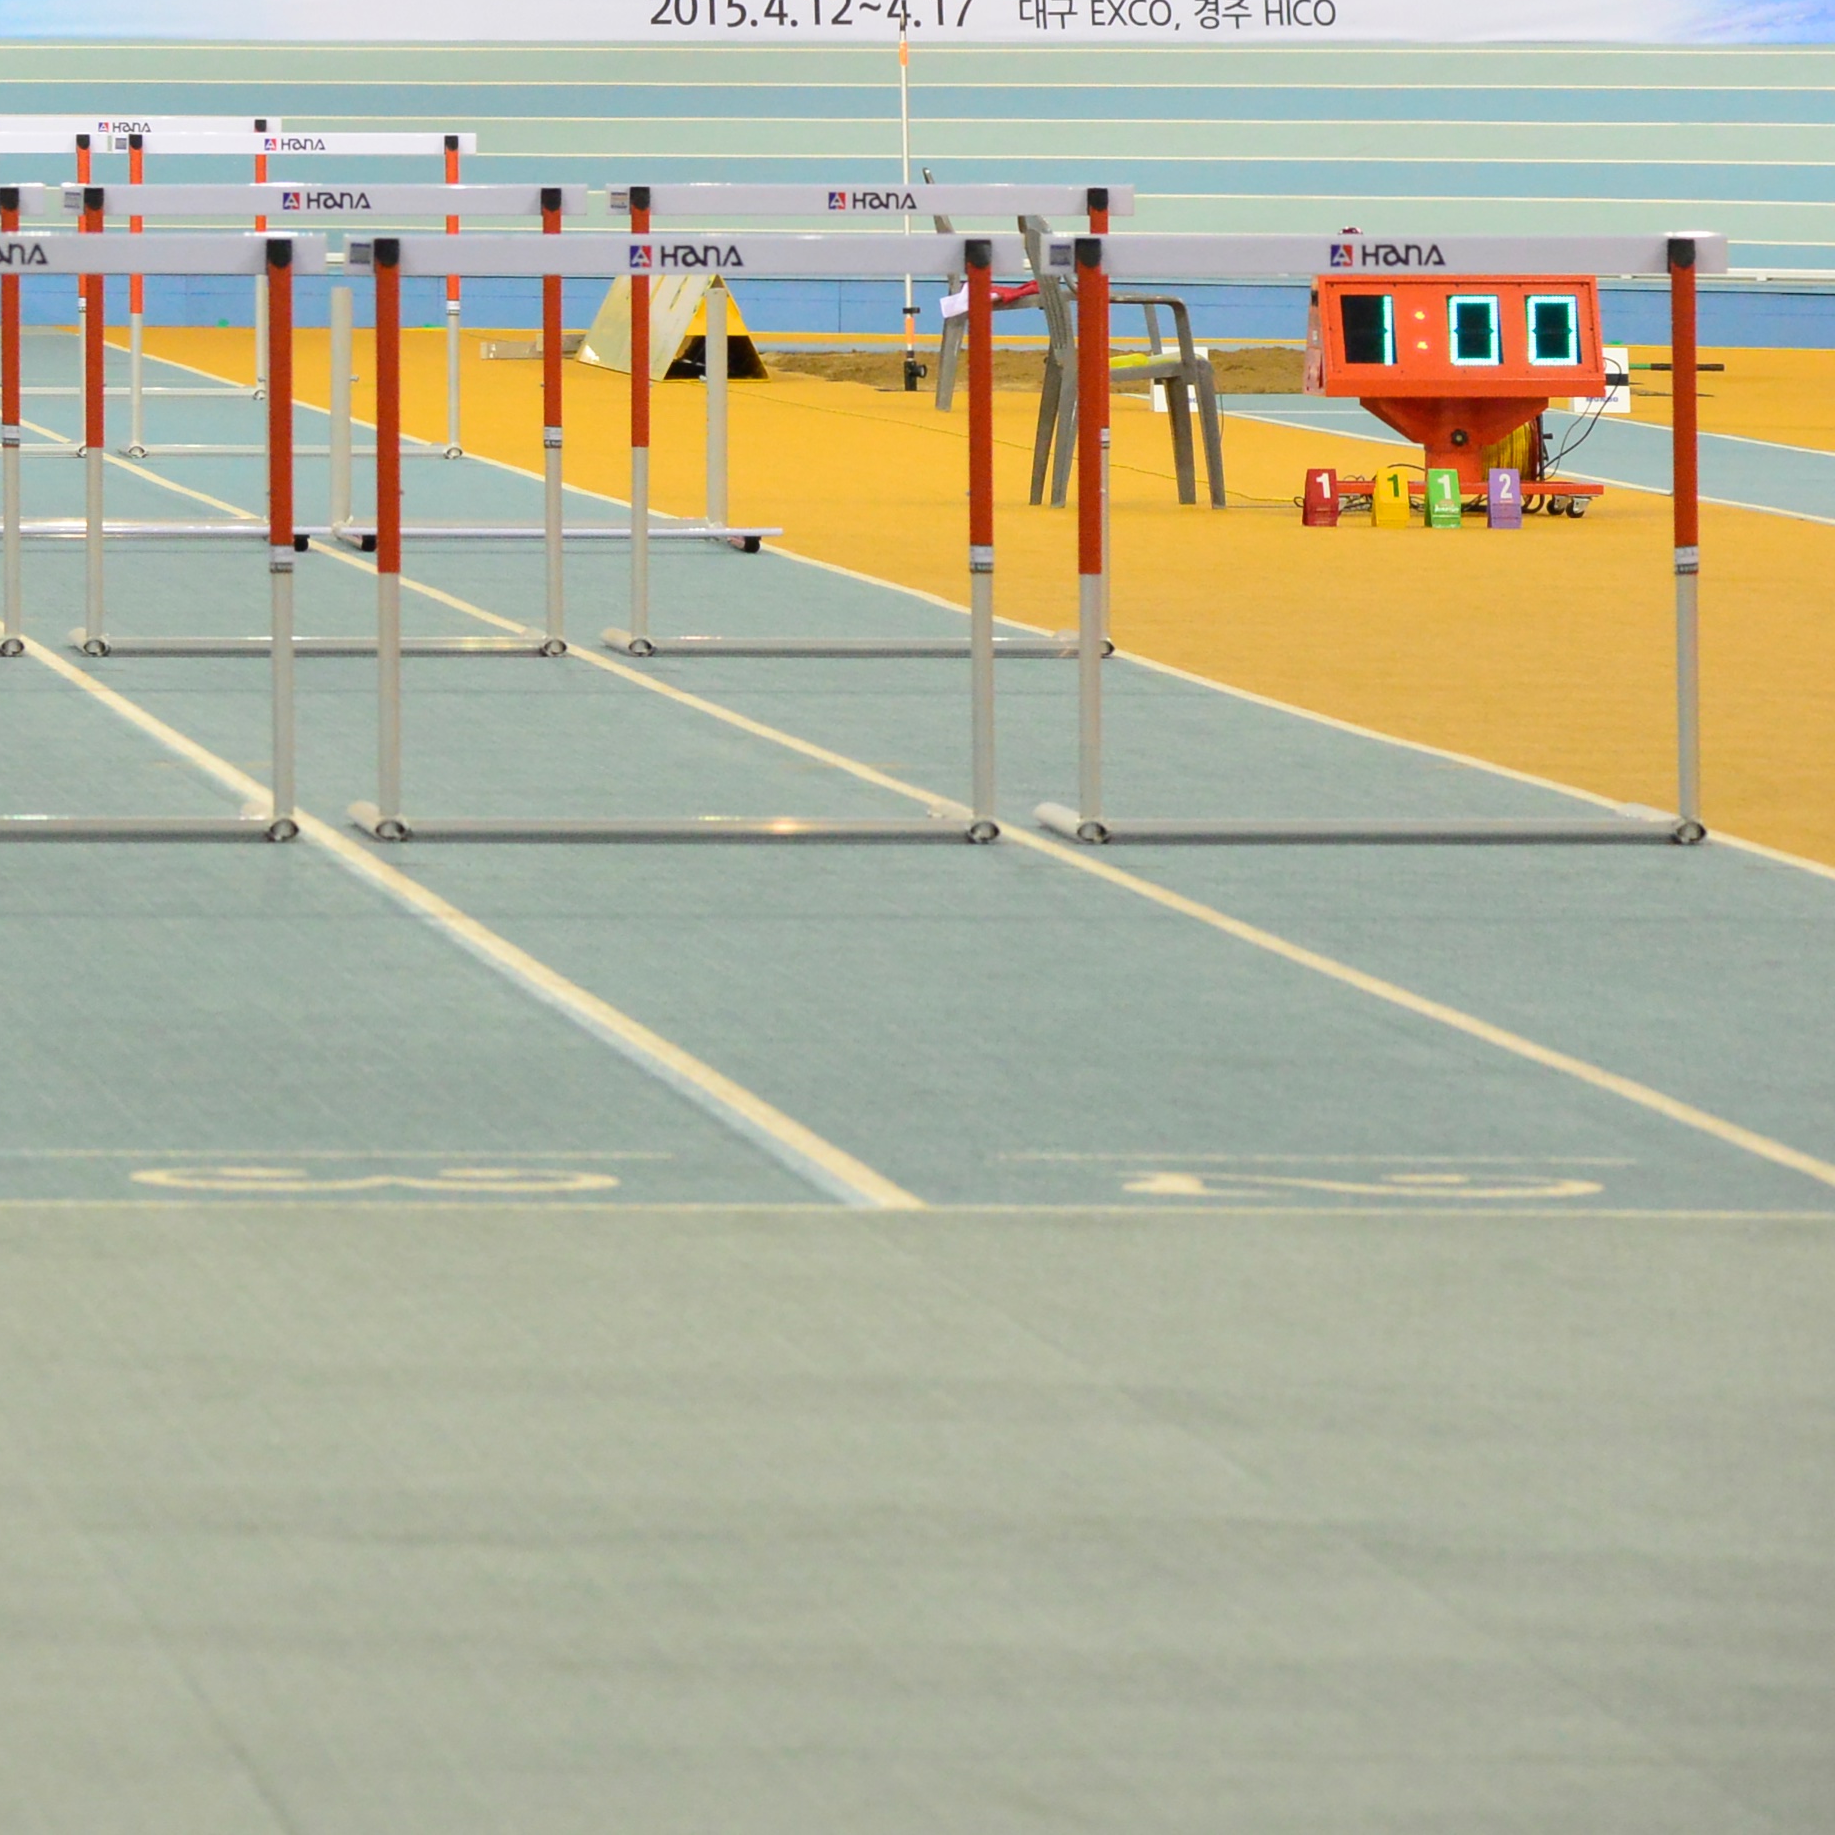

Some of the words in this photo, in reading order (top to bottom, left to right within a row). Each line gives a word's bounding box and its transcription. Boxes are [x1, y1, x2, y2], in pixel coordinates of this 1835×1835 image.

[1316, 472, 1331, 499] 1
[1387, 474, 1400, 498] 1
[1436, 474, 1452, 500] 1
[1499, 473, 1513, 499] 2
